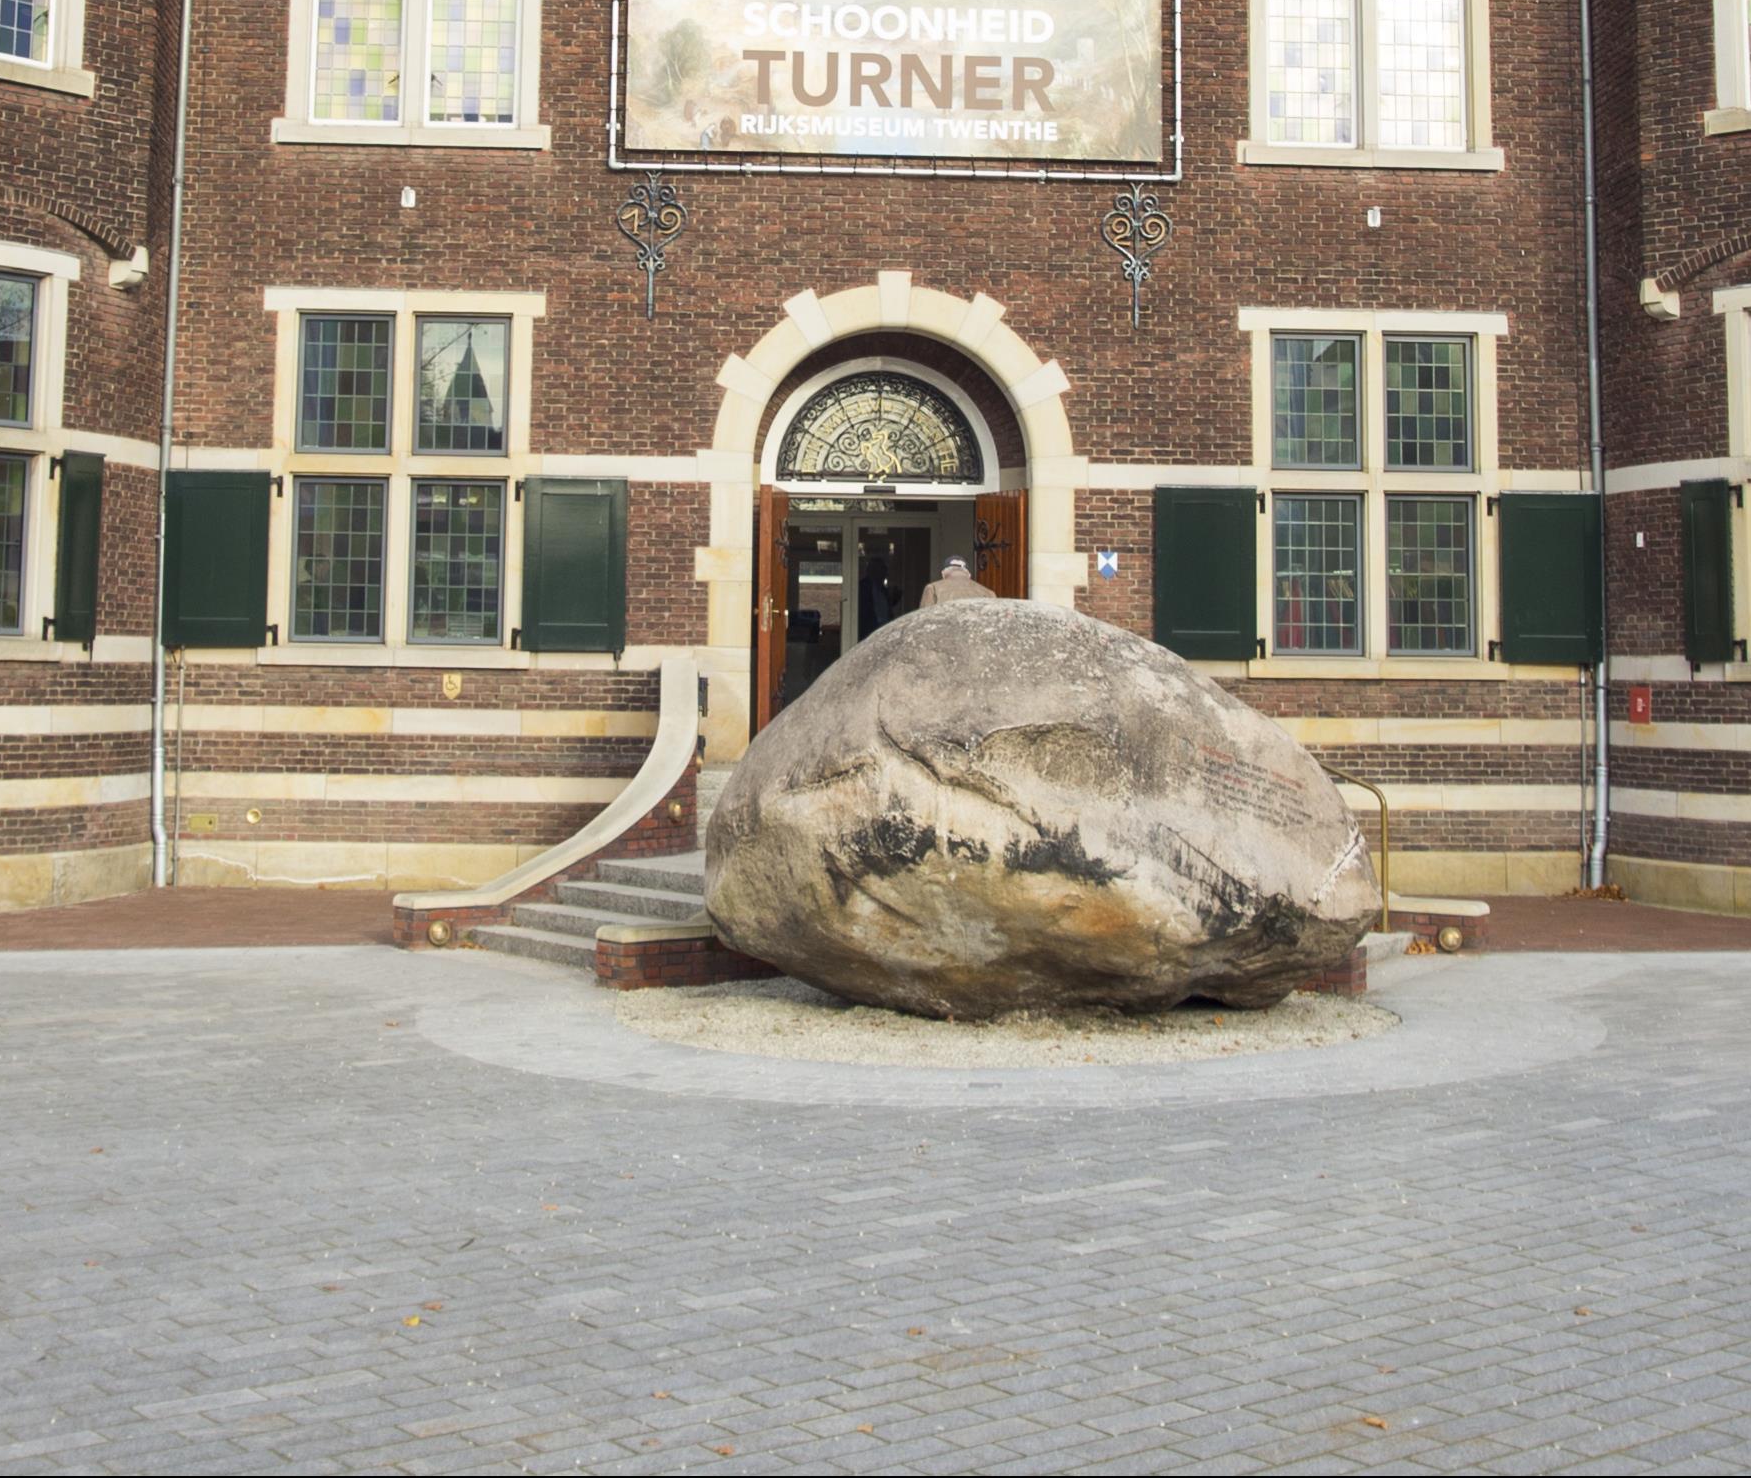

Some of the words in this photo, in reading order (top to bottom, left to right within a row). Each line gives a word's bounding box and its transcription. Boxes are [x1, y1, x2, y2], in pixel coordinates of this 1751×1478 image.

[742, 1, 1054, 45] SCHOONHEID
[743, 50, 1056, 113] TURNER
[740, 114, 926, 139] RIJKSMUSEUM
[936, 119, 1058, 141] TWENTHE
